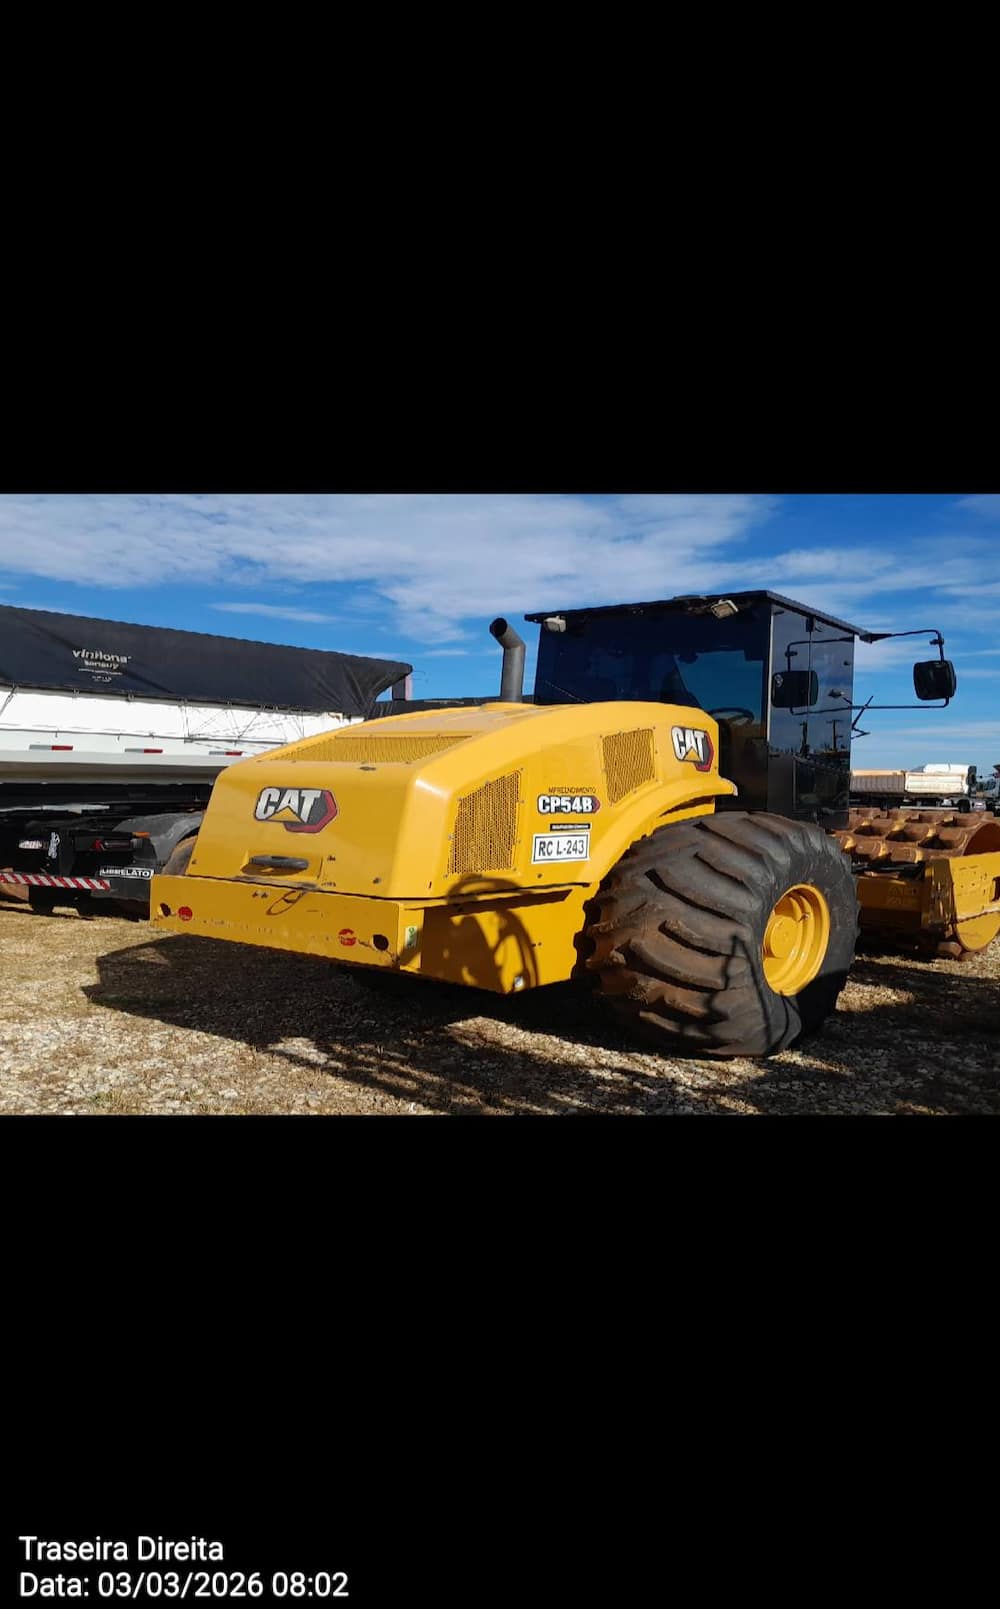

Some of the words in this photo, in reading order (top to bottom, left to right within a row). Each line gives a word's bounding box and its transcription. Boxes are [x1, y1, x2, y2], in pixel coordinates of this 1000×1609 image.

[671, 726, 705, 763] CAT
[254, 787, 322, 823] CAT
[537, 794, 594, 814] CP54B
[538, 840, 554, 857] RC
[556, 839, 585, 856] L-243
